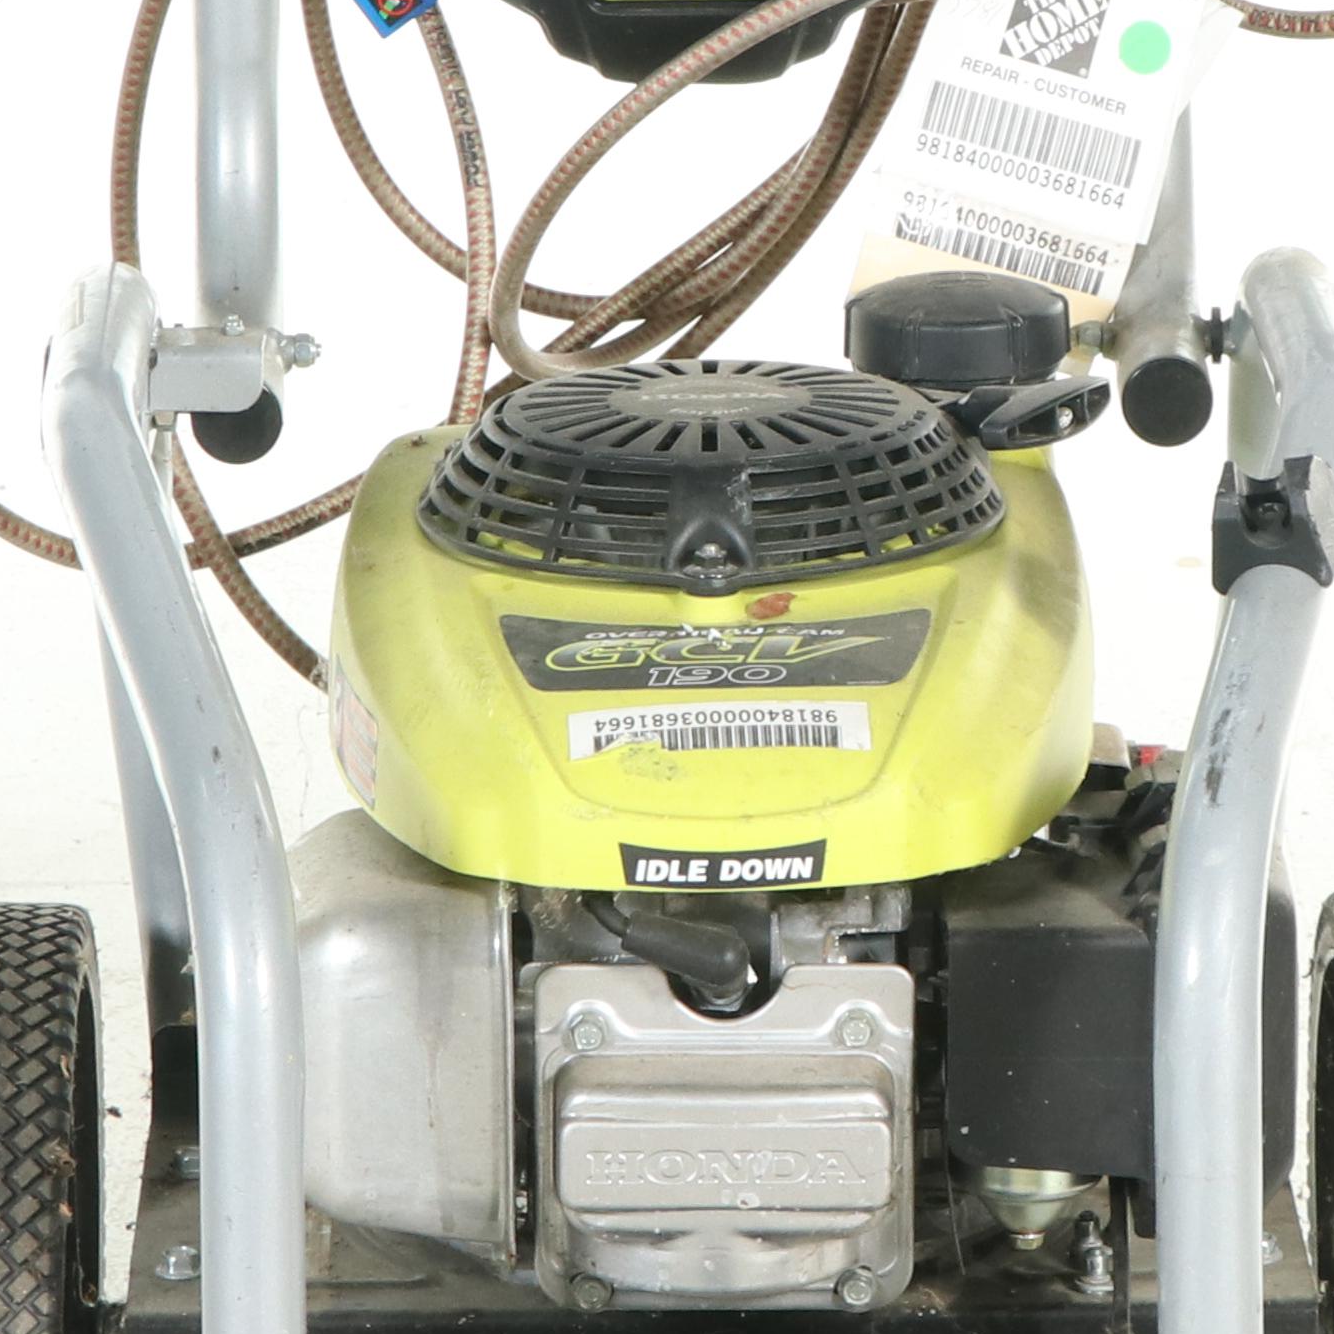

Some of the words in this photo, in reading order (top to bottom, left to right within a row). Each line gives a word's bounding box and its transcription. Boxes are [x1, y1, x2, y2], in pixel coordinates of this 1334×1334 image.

[1033, 16, 1100, 66] DEPOT
[960, 56, 1020, 85] REPAIR
[1033, 77, 1128, 116] CUSTOMER
[916, 133, 1125, 210] 98184000003681664
[903, 191, 1110, 266] 9814000003681664
[545, 636, 886, 671] GCV
[648, 664, 787, 687] 190
[595, 709, 838, 732] 98184000003681664
[635, 859, 709, 882] IDLE
[719, 857, 814, 882] DOWN
[586, 1150, 866, 1185] HONDA
